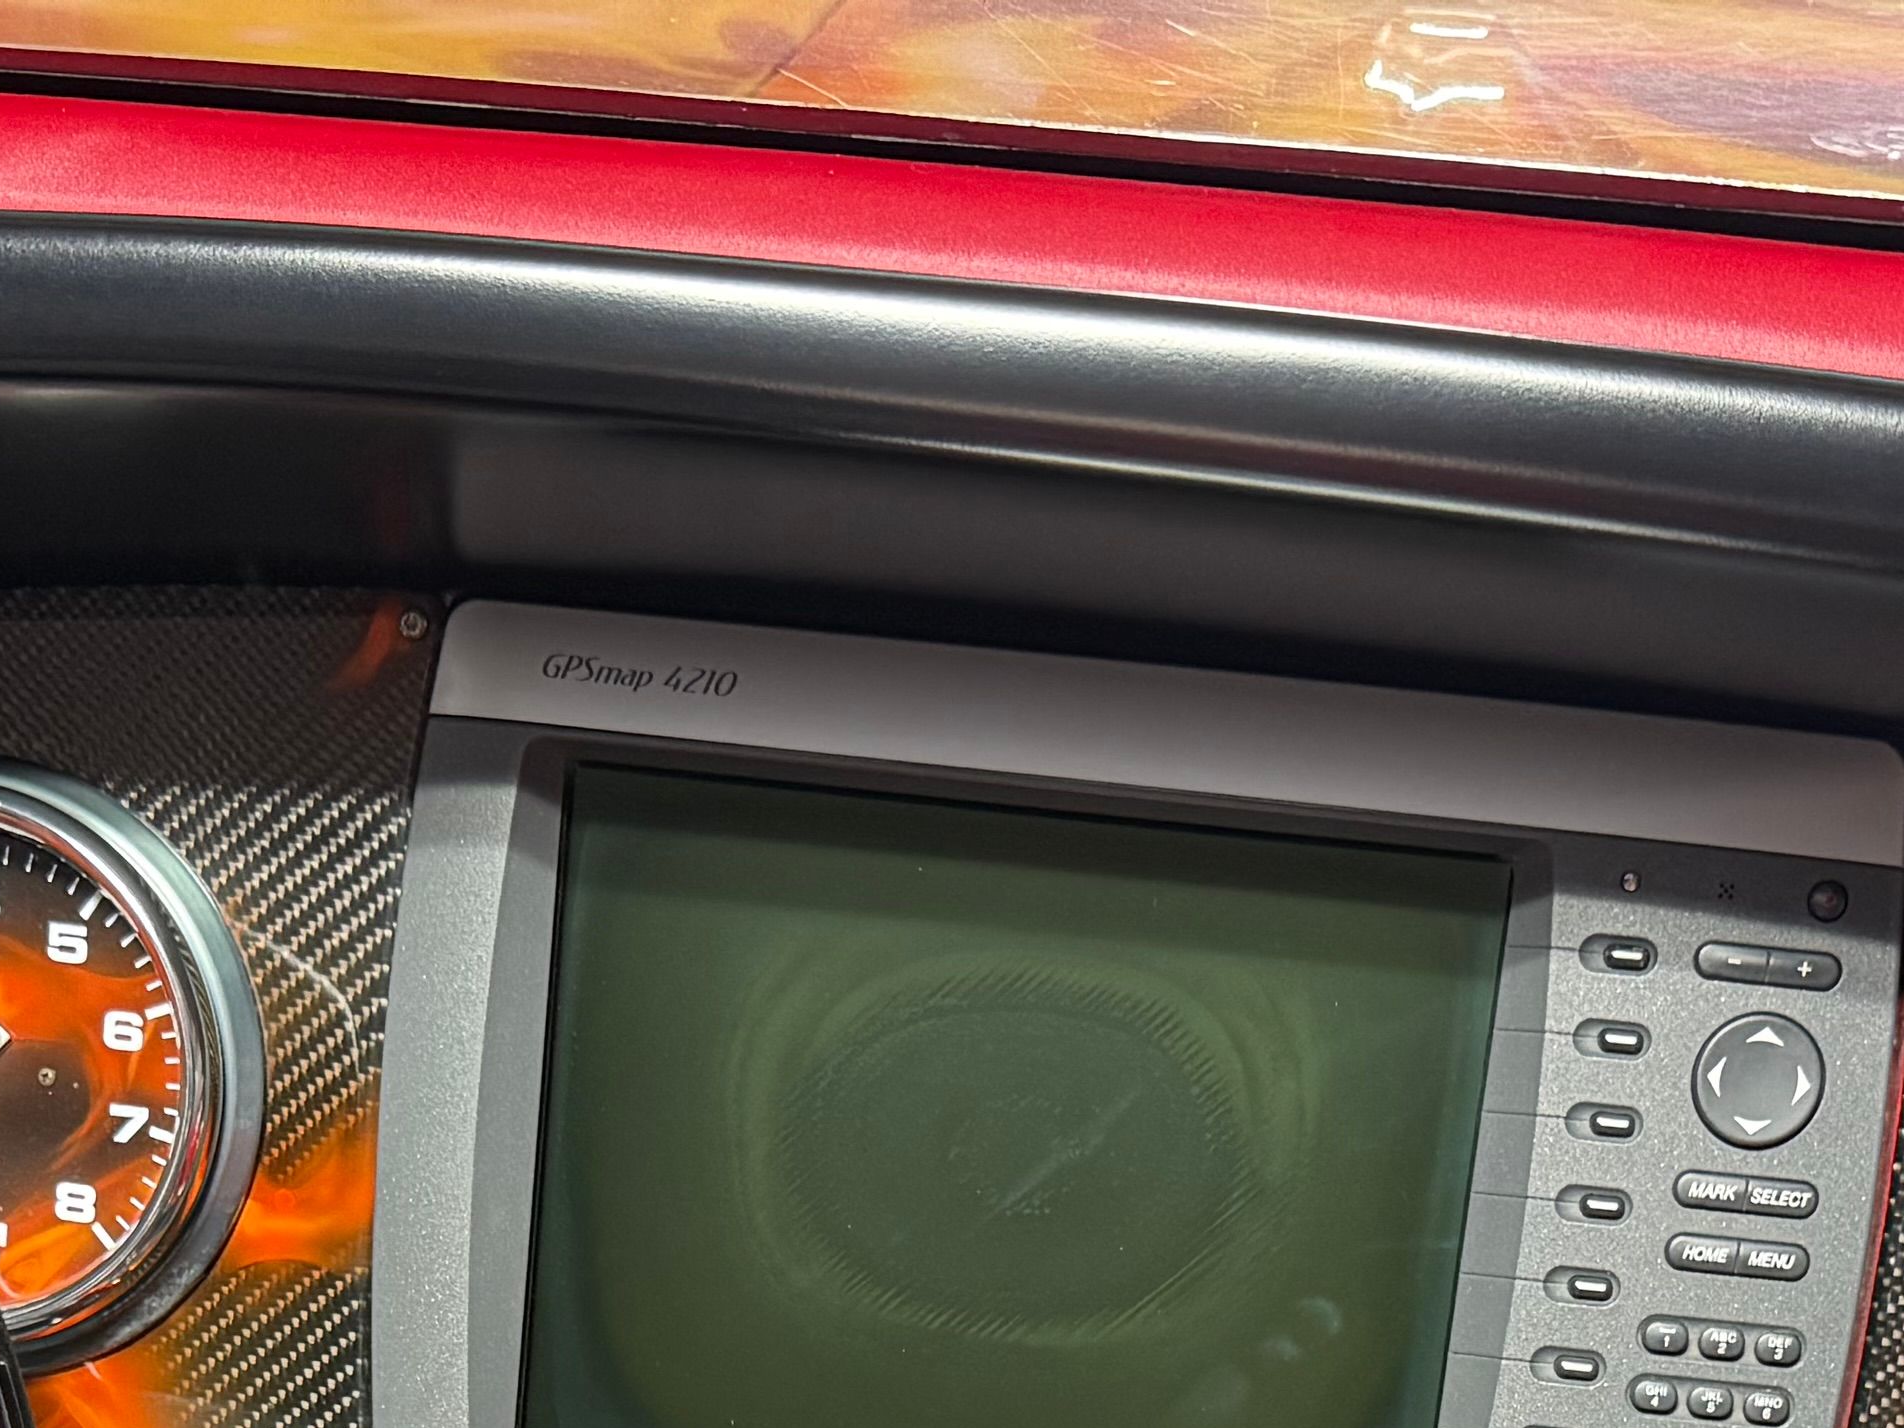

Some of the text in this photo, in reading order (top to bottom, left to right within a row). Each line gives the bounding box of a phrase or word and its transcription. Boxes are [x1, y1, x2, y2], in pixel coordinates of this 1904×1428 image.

[542, 653, 738, 697] GPSmap 4210
[47, 922, 88, 964] 5
[103, 1011, 144, 1052] 6
[109, 1104, 149, 1143] 7
[1688, 1181, 1738, 1201] MARK
[1750, 1187, 1812, 1208] SELECT
[55, 1182, 97, 1224] 8
[1682, 1244, 1730, 1263] HOME
[1748, 1251, 1795, 1270] MENU
[1710, 1329, 1737, 1343] ABC
[1768, 1335, 1793, 1348] DEF
[1717, 1343, 1726, 1355] 2
[1773, 1349, 1783, 1360] 3
[1646, 1385, 1668, 1397] GHI
[1650, 1396, 1659, 1408] 4
[1754, 1396, 1783, 1409] MNO
